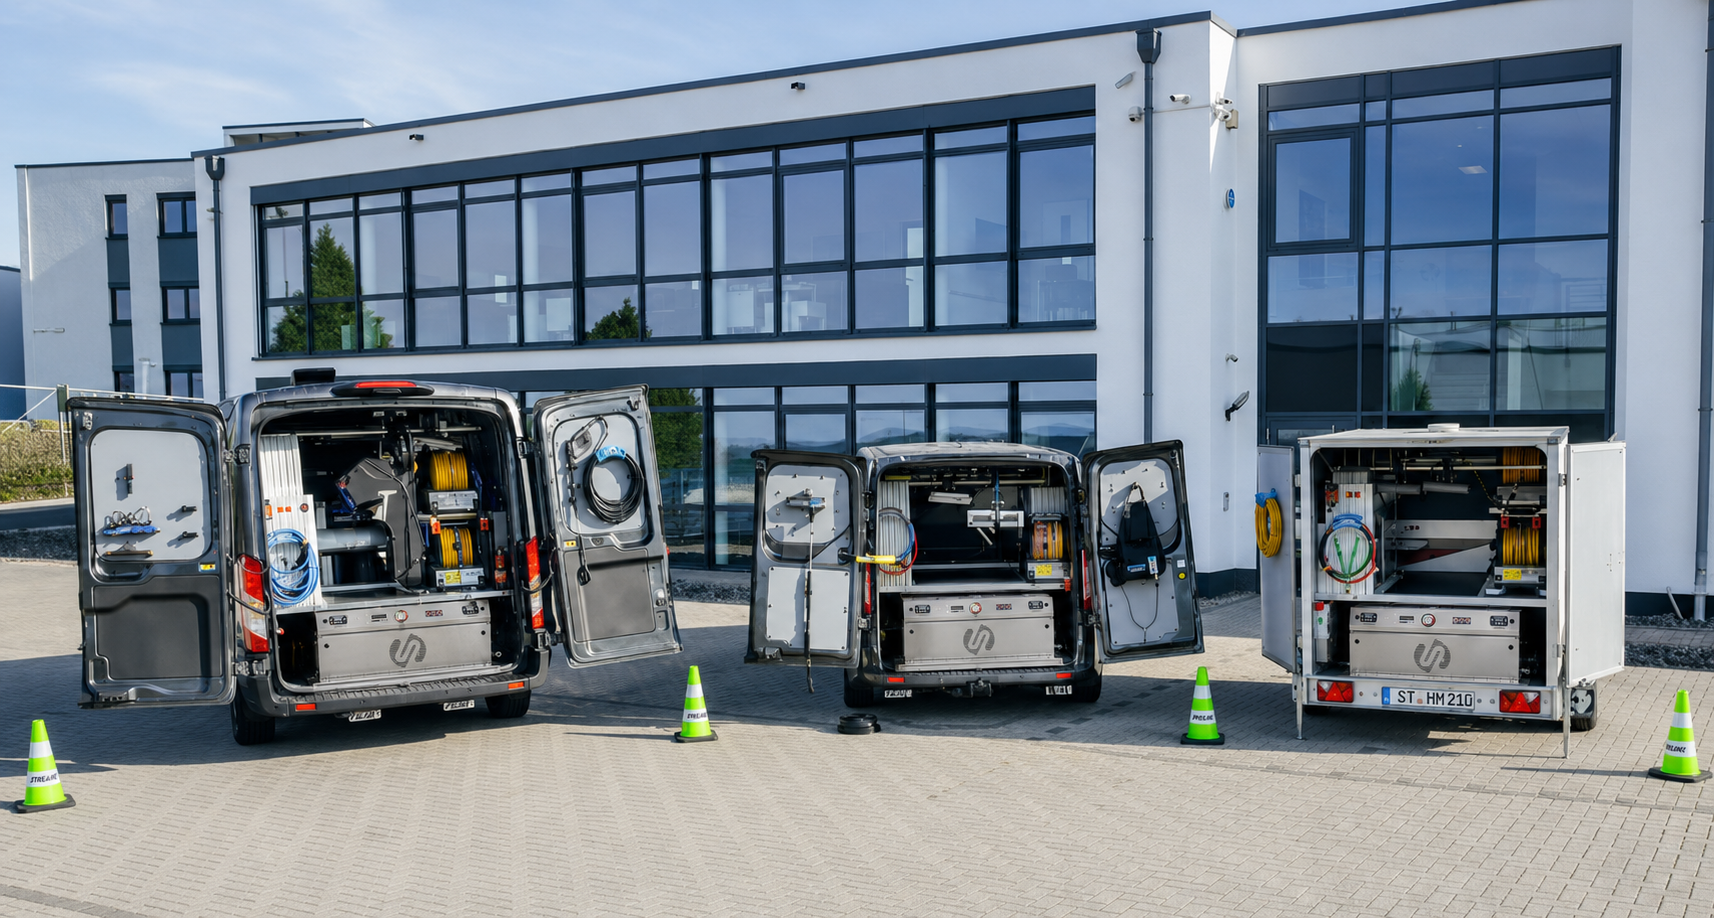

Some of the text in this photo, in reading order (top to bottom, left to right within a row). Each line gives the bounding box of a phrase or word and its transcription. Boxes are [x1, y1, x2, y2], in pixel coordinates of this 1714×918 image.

[1397, 690, 1473, 707] ST HM 210
